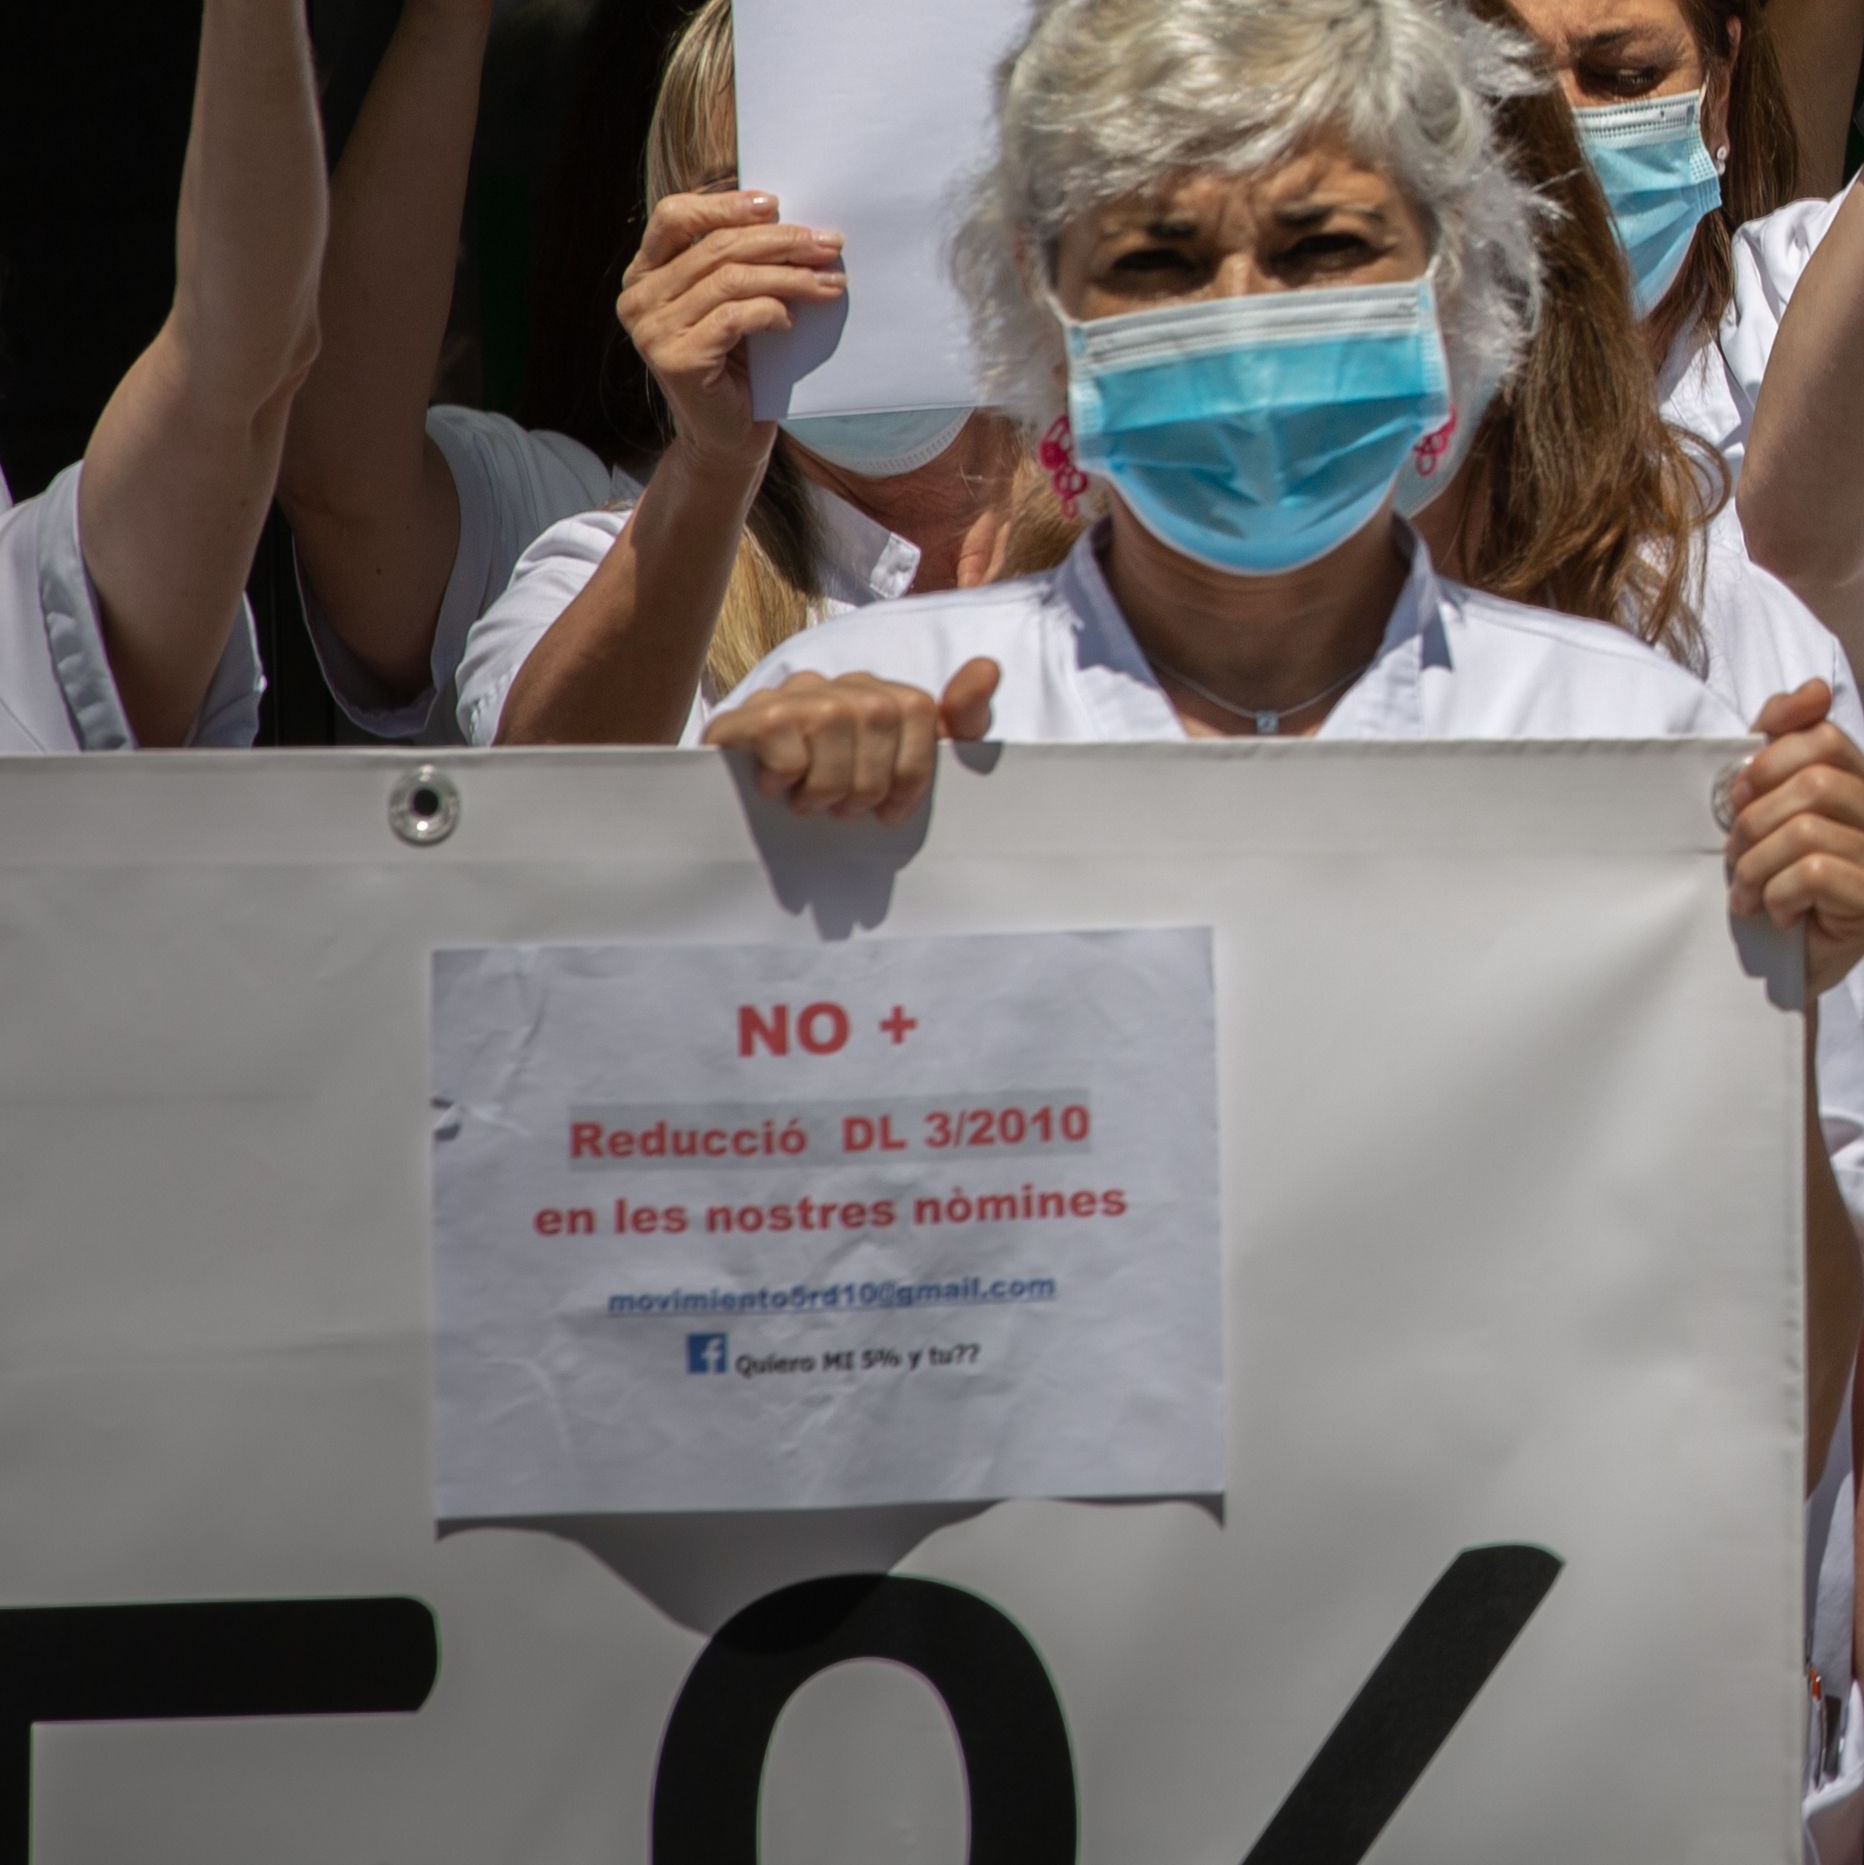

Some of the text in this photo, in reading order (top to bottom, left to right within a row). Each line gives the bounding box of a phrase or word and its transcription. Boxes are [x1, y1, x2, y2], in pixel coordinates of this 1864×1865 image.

[737, 1003, 919, 1057] NO +
[569, 1105, 1091, 1160] Reducció DL 3/2010
[533, 1183, 1128, 1236] en les nostres nòmines
[734, 1353, 816, 1379] Quiero
[822, 1349, 854, 1372] MI
[906, 1348, 924, 1371] y
[929, 1342, 981, 1366] tu??
